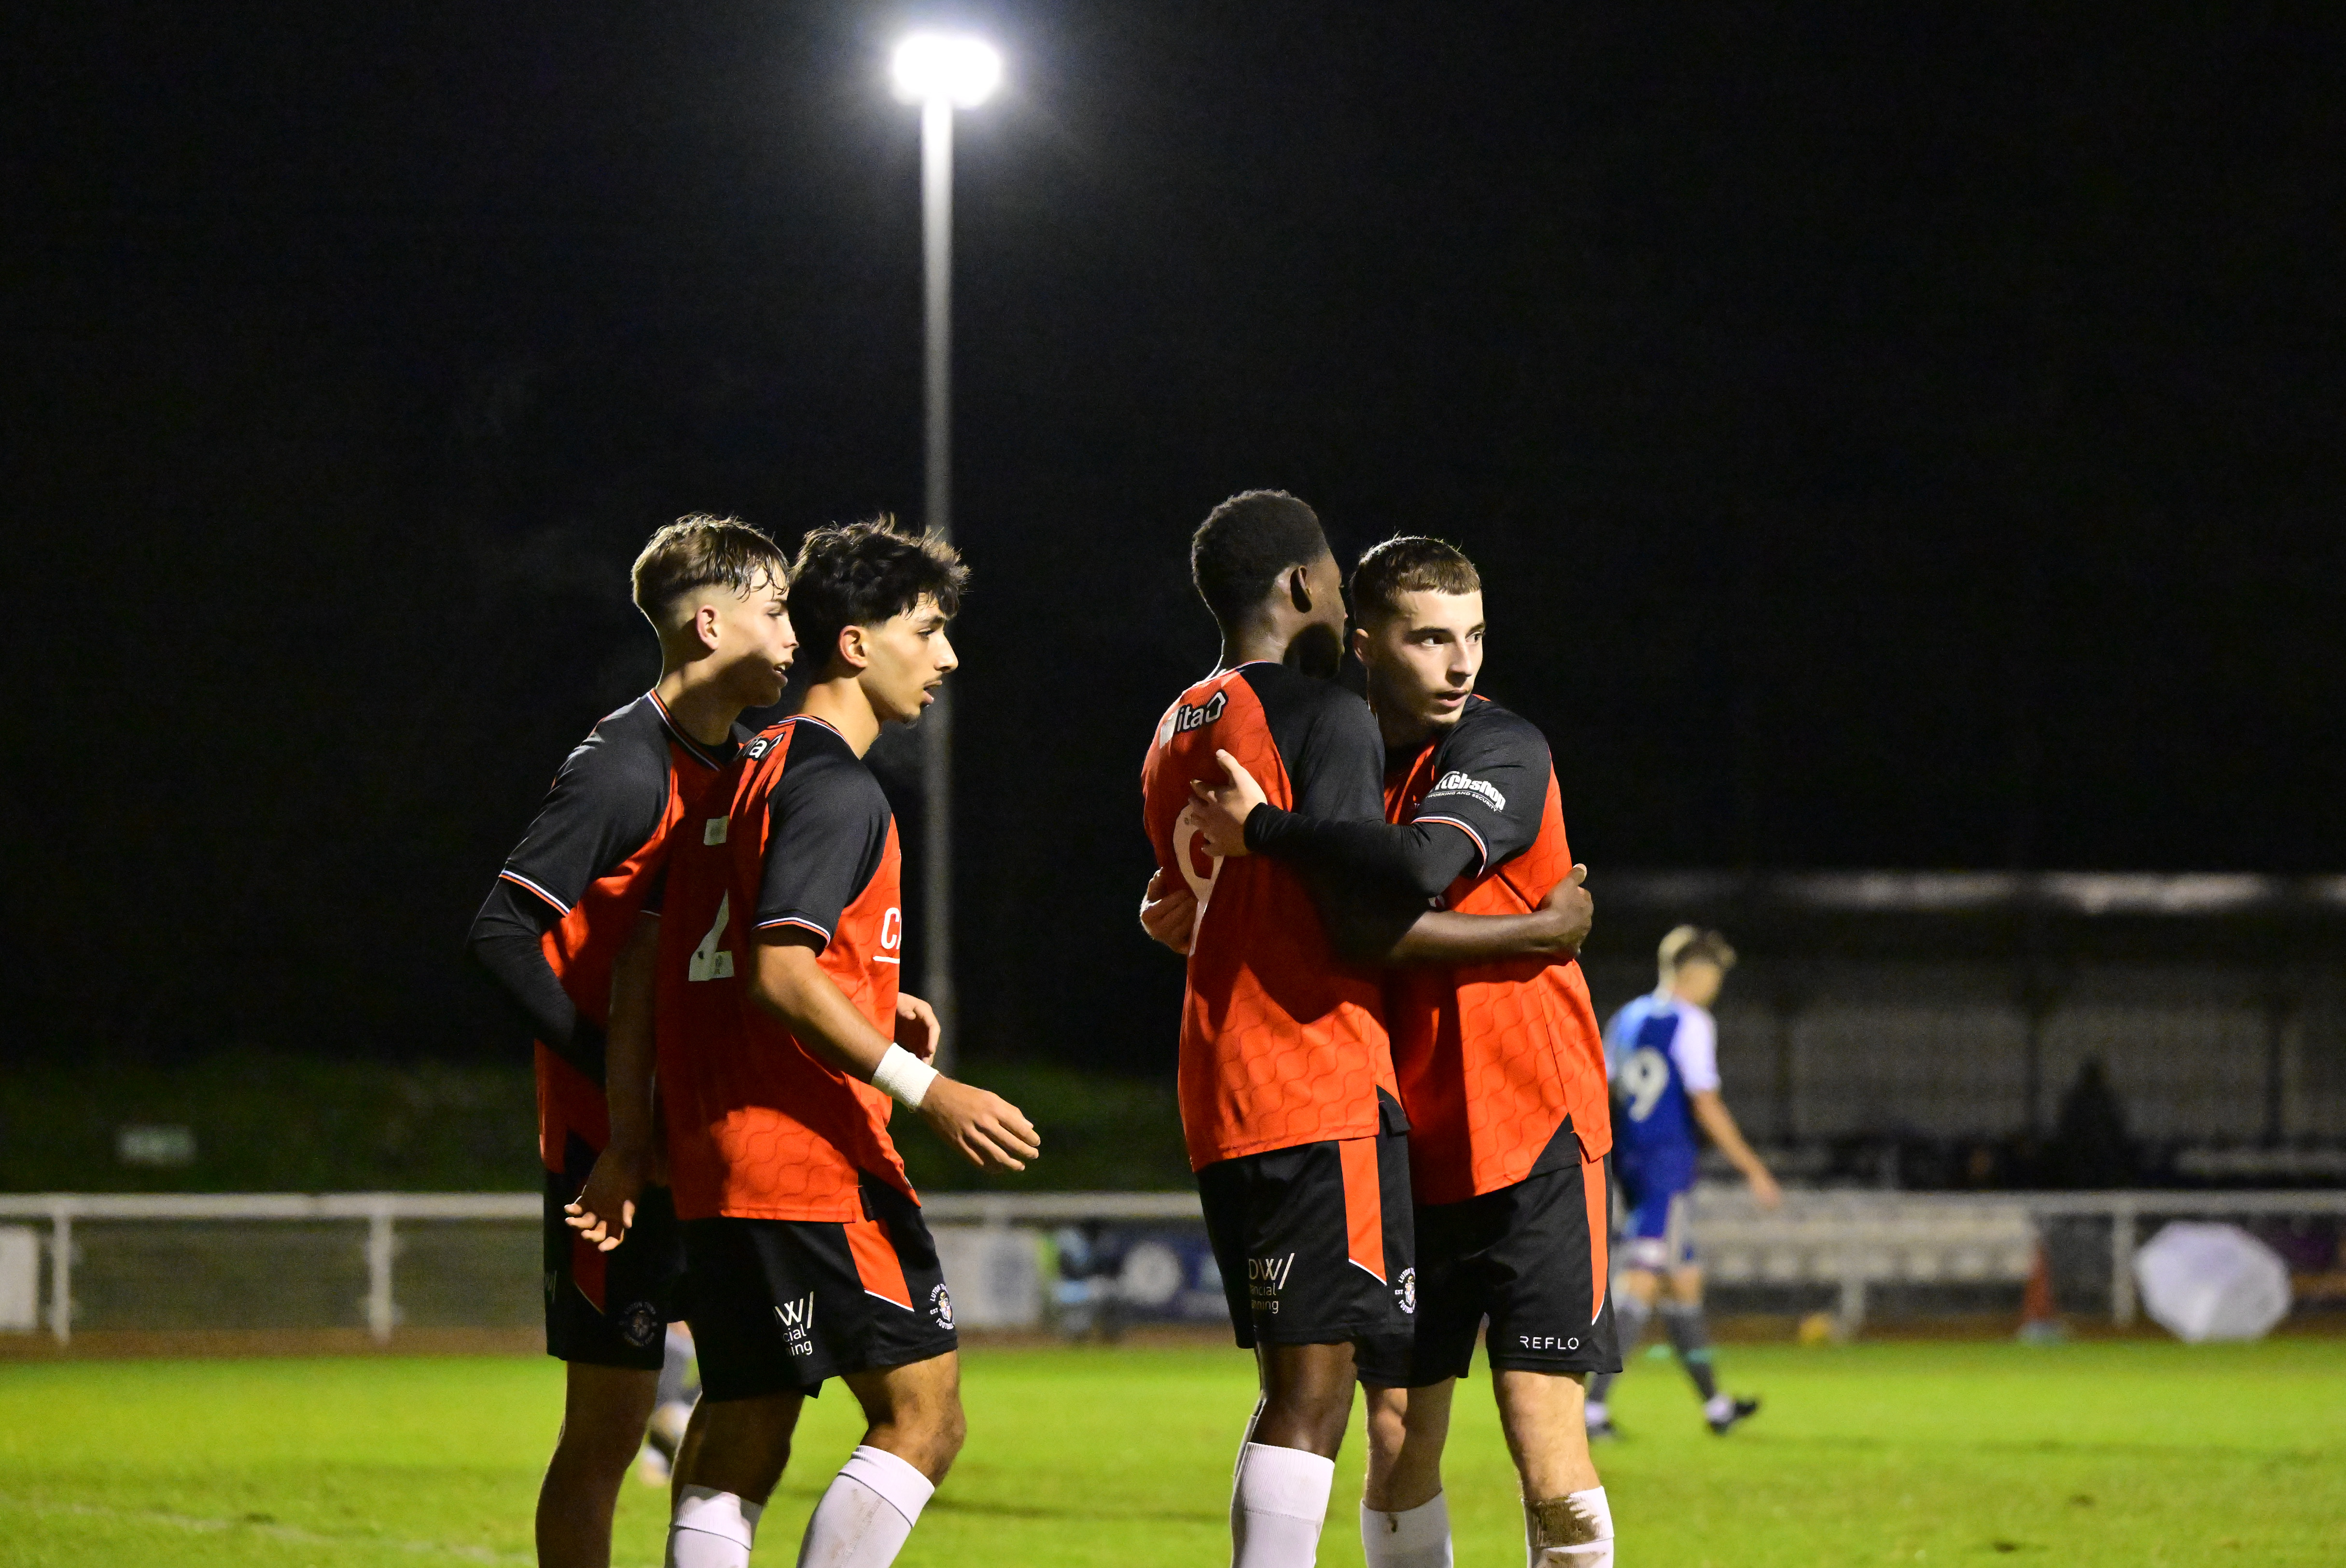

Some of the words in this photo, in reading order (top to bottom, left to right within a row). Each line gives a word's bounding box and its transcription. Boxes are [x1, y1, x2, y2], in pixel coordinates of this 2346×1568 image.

[1472, 793, 1497, 812] SECURITY
[881, 907, 902, 950] C
[930, 1284, 941, 1302] LUTON
[773, 1291, 814, 1329] W/
[1520, 1335, 1579, 1350] REFLO
